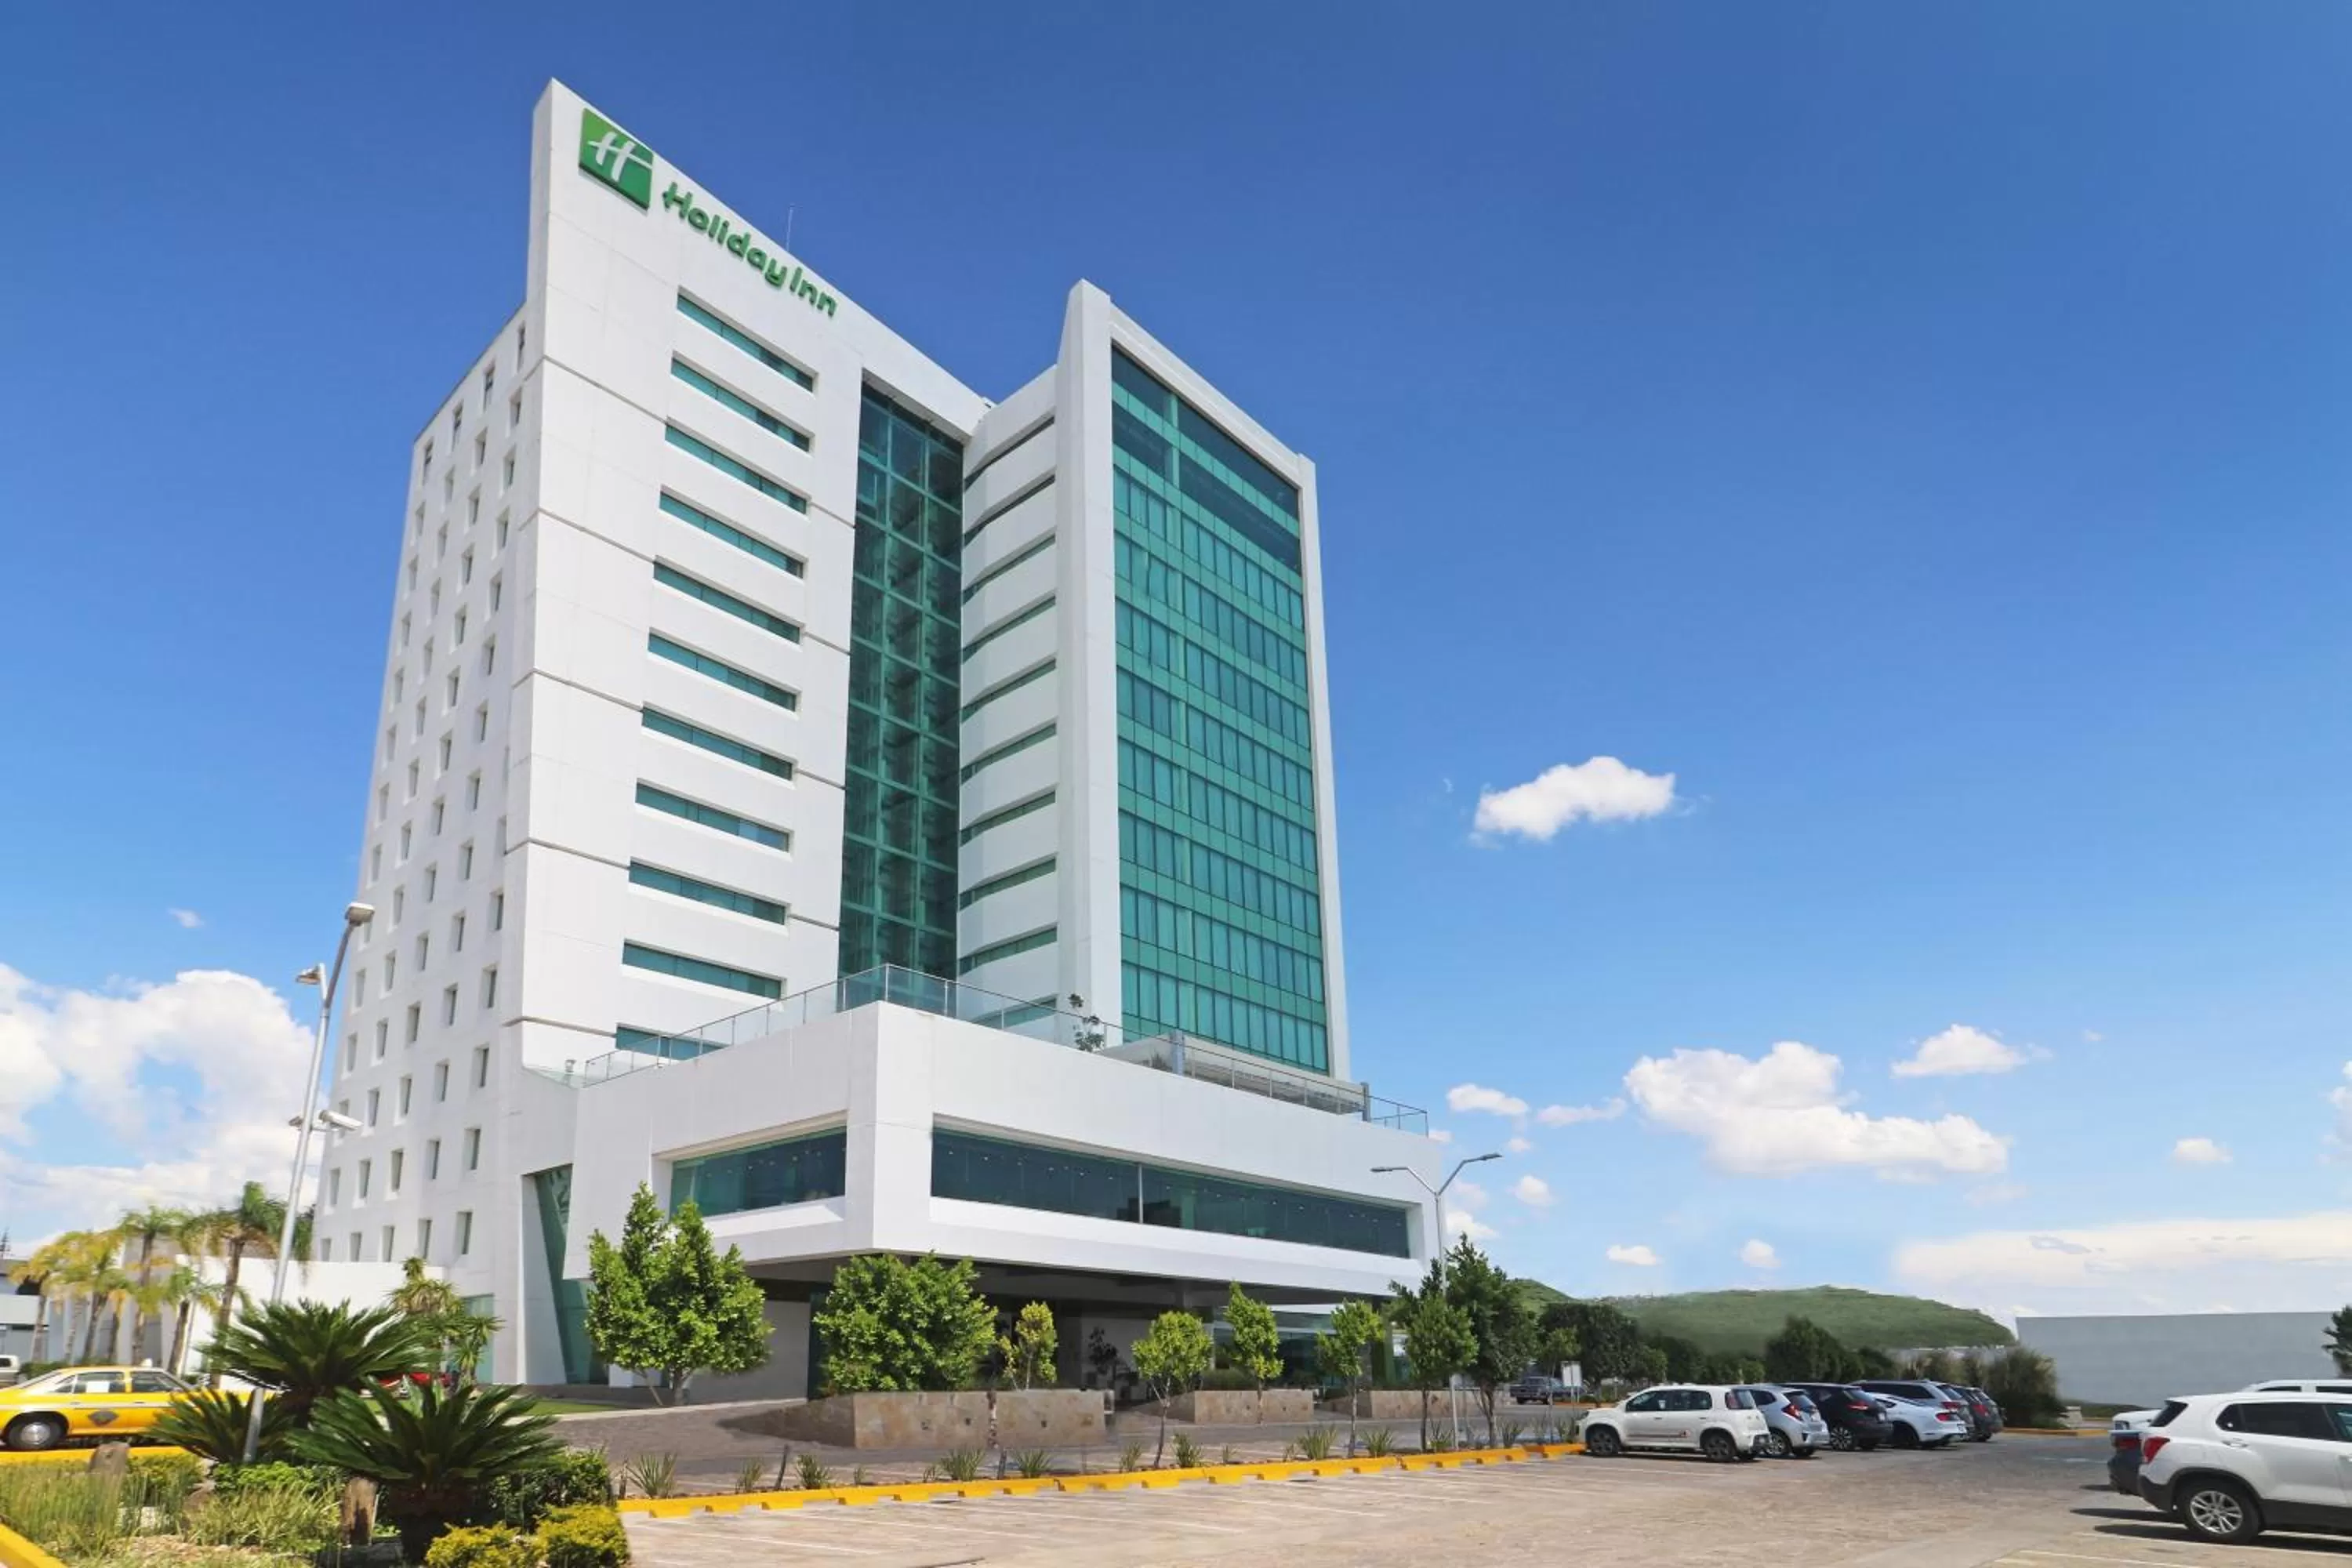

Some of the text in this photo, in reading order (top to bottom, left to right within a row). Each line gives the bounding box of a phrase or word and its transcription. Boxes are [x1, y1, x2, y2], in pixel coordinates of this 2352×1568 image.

[587, 132, 652, 181] H
[662, 182, 837, 317] Holiday Inn
